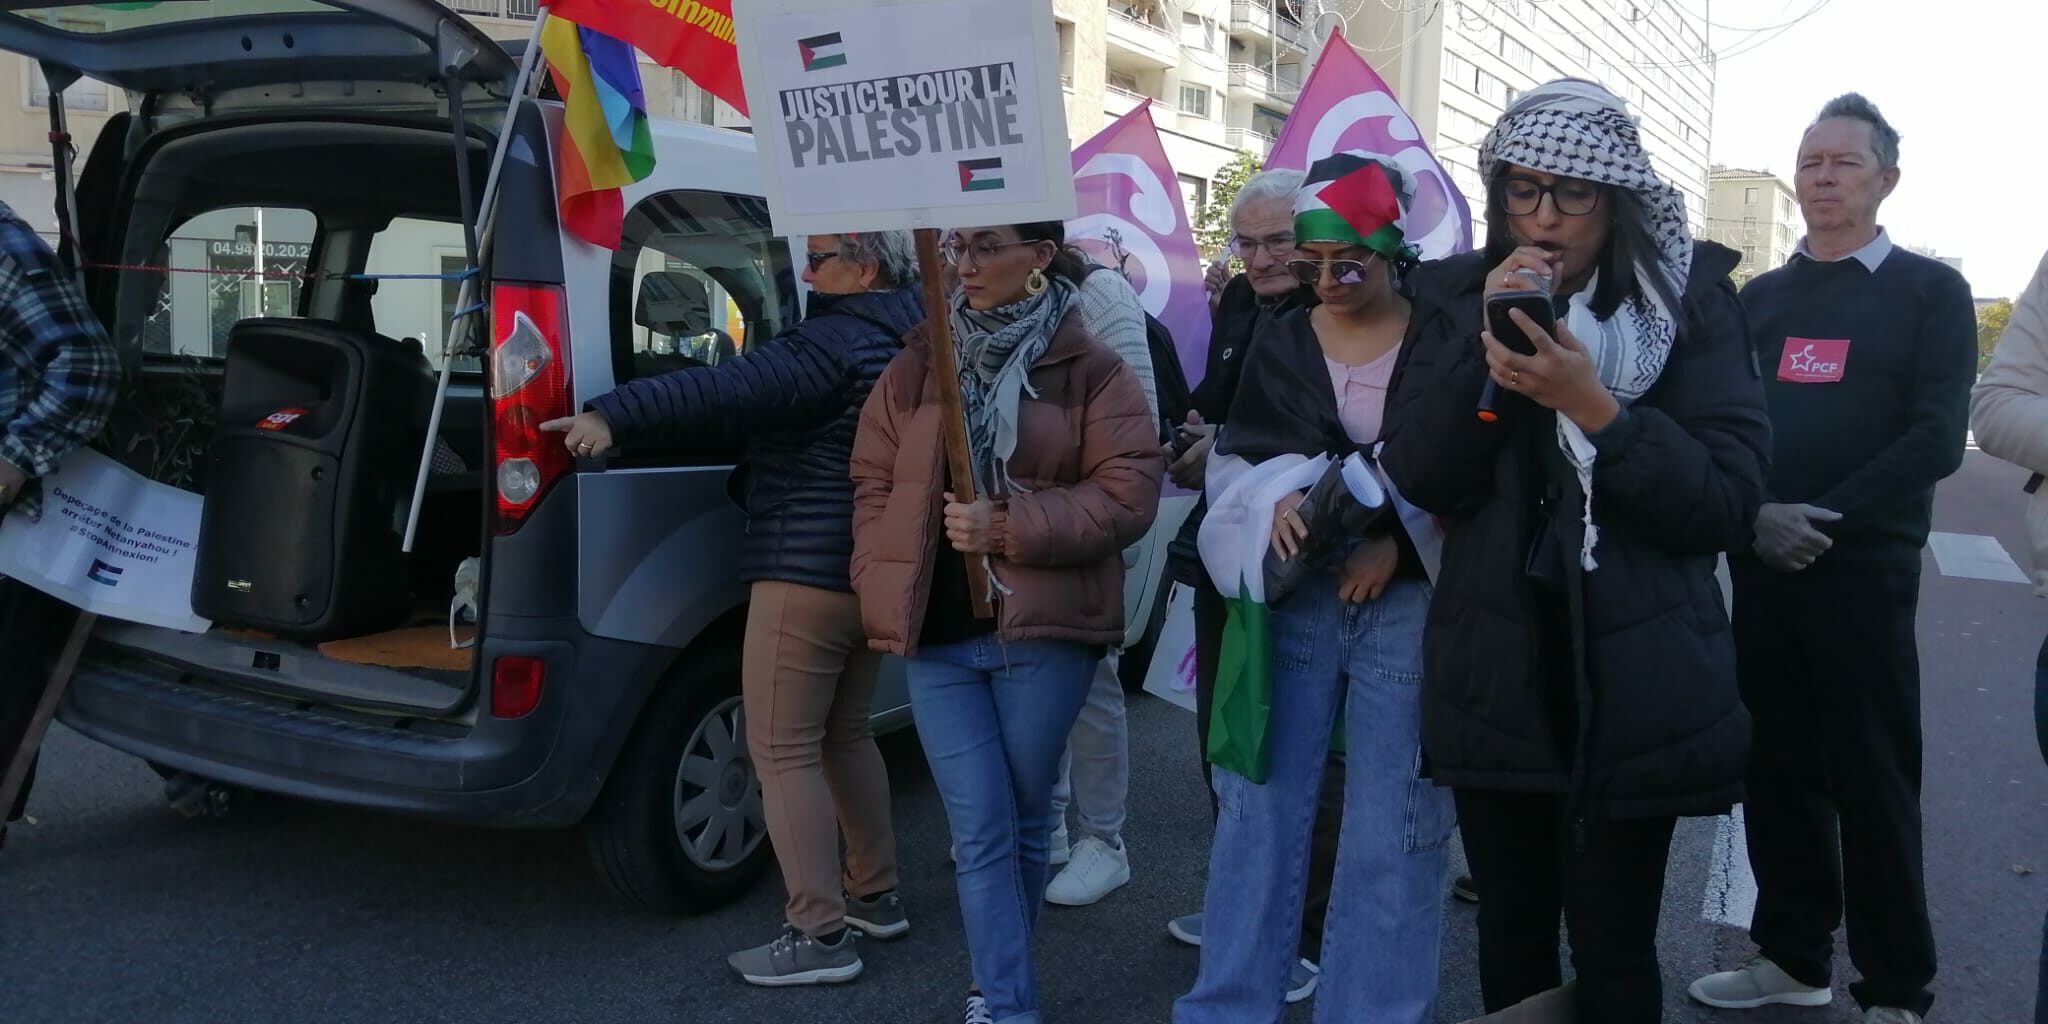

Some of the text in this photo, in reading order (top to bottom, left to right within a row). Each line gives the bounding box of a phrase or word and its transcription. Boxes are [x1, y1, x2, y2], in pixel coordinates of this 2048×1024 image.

[785, 64, 1017, 122] JUSTICE POUR LA
[785, 95, 1024, 168] PALESTINE
[1811, 362, 1838, 373] PCF
[267, 412, 300, 423] cgt
[104, 525, 170, 554] Netanyahou
[110, 514, 122, 527] de
[123, 522, 134, 533] la
[137, 527, 191, 548] Palestine
